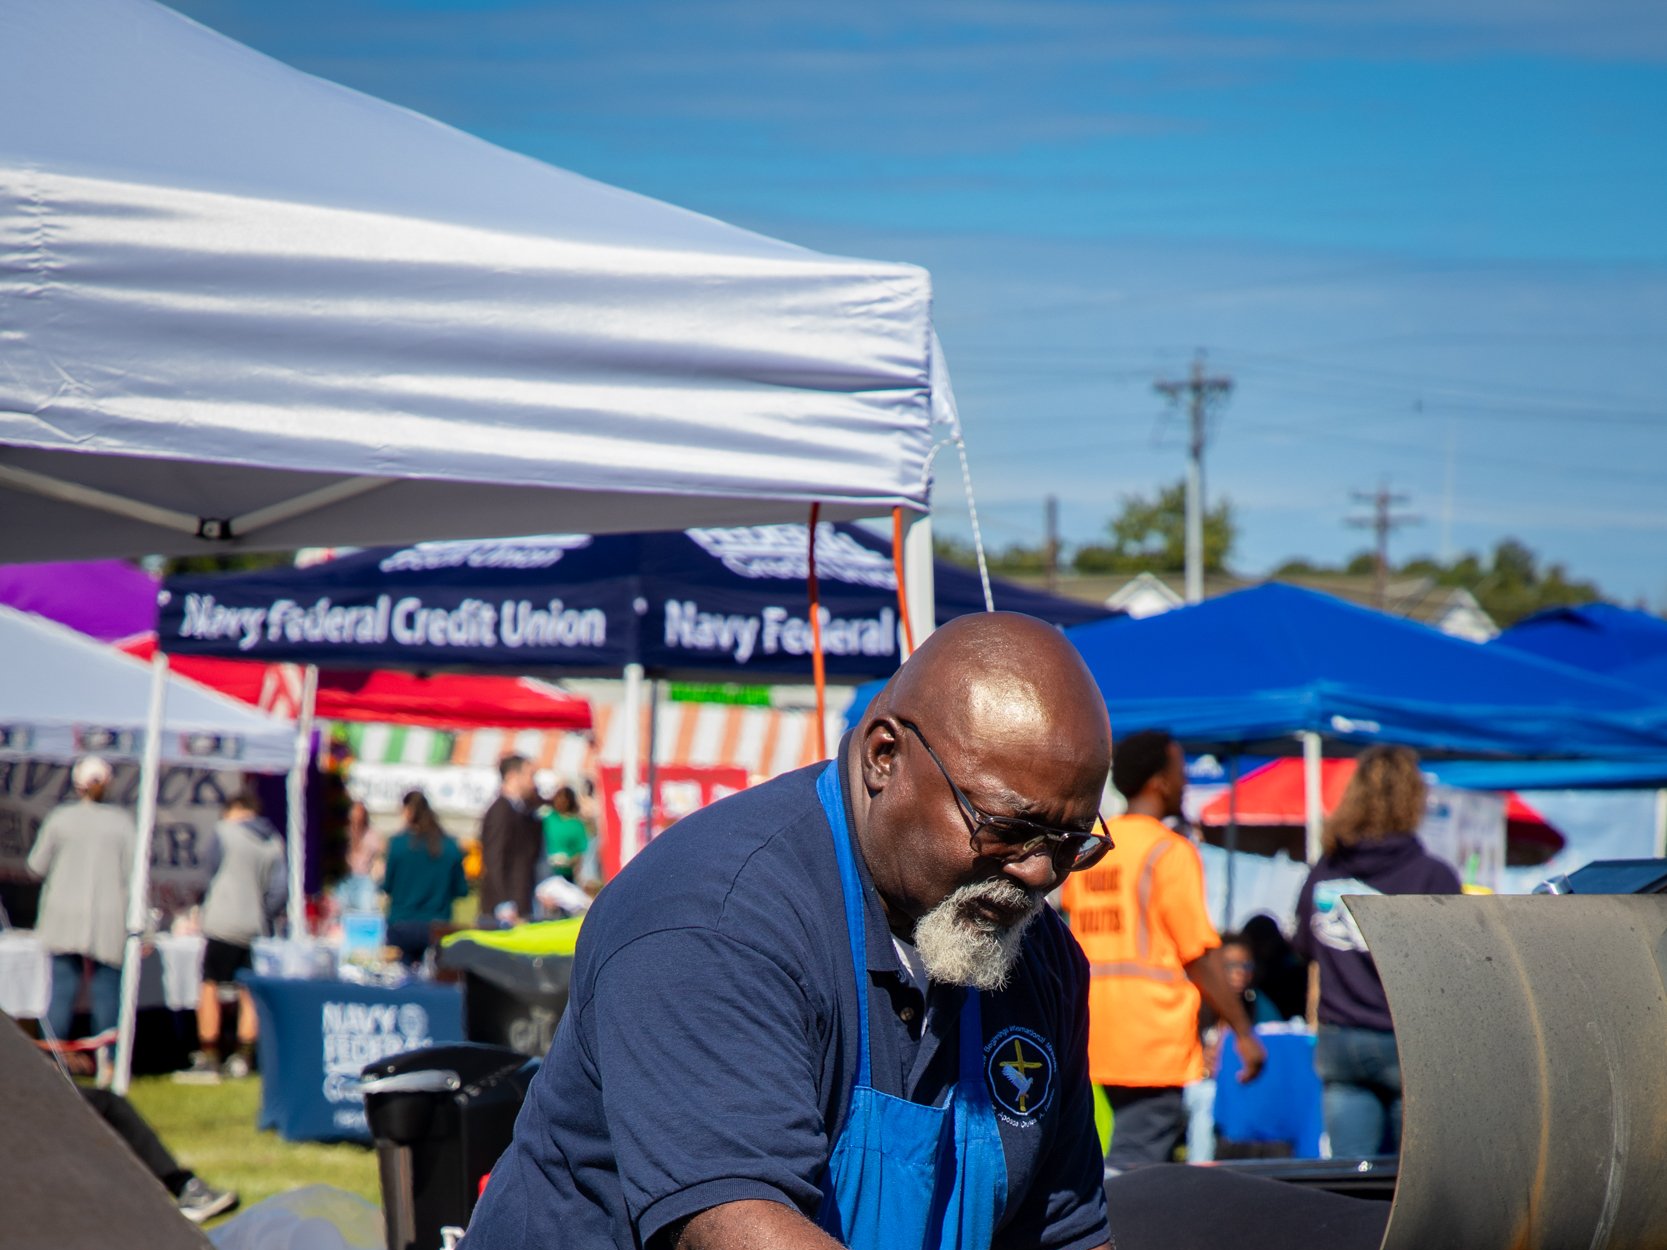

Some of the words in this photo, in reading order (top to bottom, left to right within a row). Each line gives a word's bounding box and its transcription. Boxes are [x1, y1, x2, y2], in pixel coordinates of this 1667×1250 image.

[179, 593, 266, 650] Navy
[267, 595, 391, 644] Federal
[391, 597, 497, 646] Credit
[501, 598, 607, 647] Union
[664, 600, 760, 663] Navy
[322, 1002, 398, 1034] NAVY
